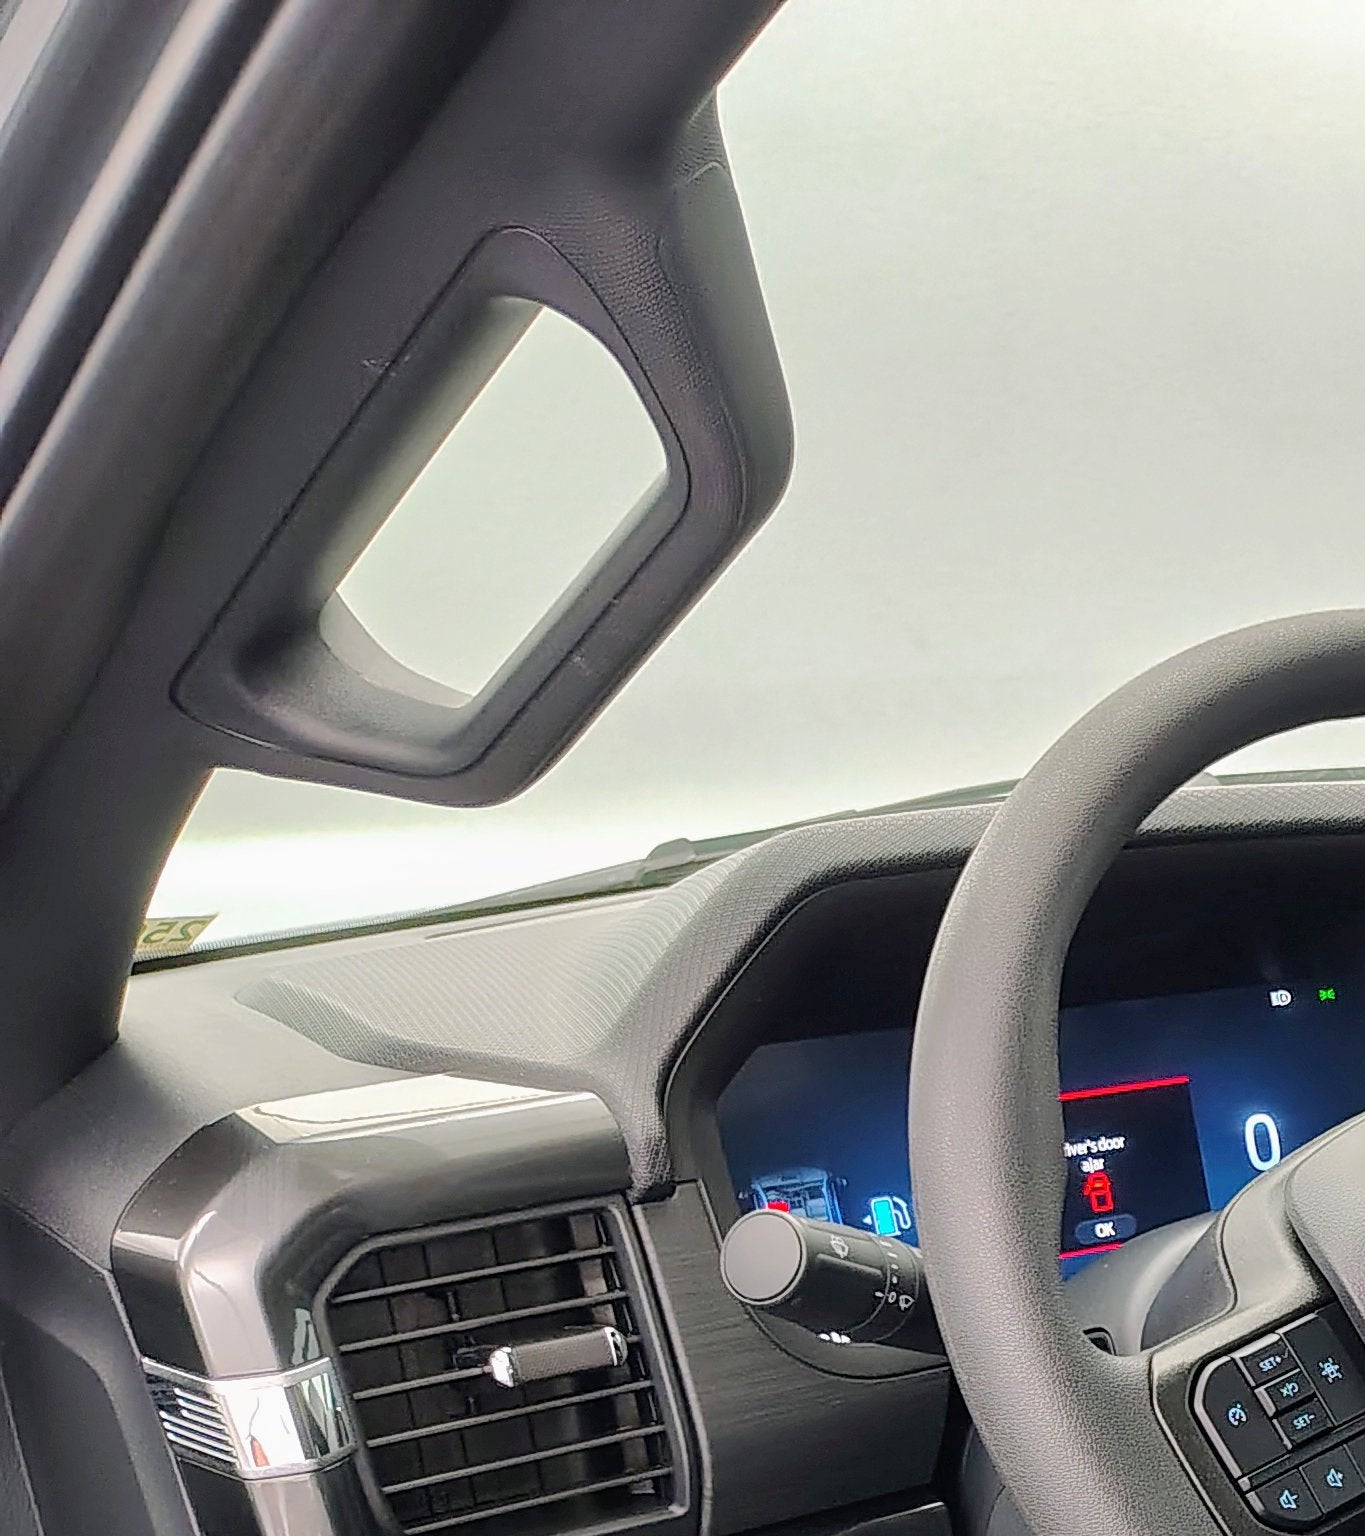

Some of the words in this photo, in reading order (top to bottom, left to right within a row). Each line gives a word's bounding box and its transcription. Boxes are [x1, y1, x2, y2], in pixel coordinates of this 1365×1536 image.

[1098, 1136, 1125, 1152] door
[1244, 1113, 1281, 1171] 0
[1094, 1222, 1116, 1238] OK
